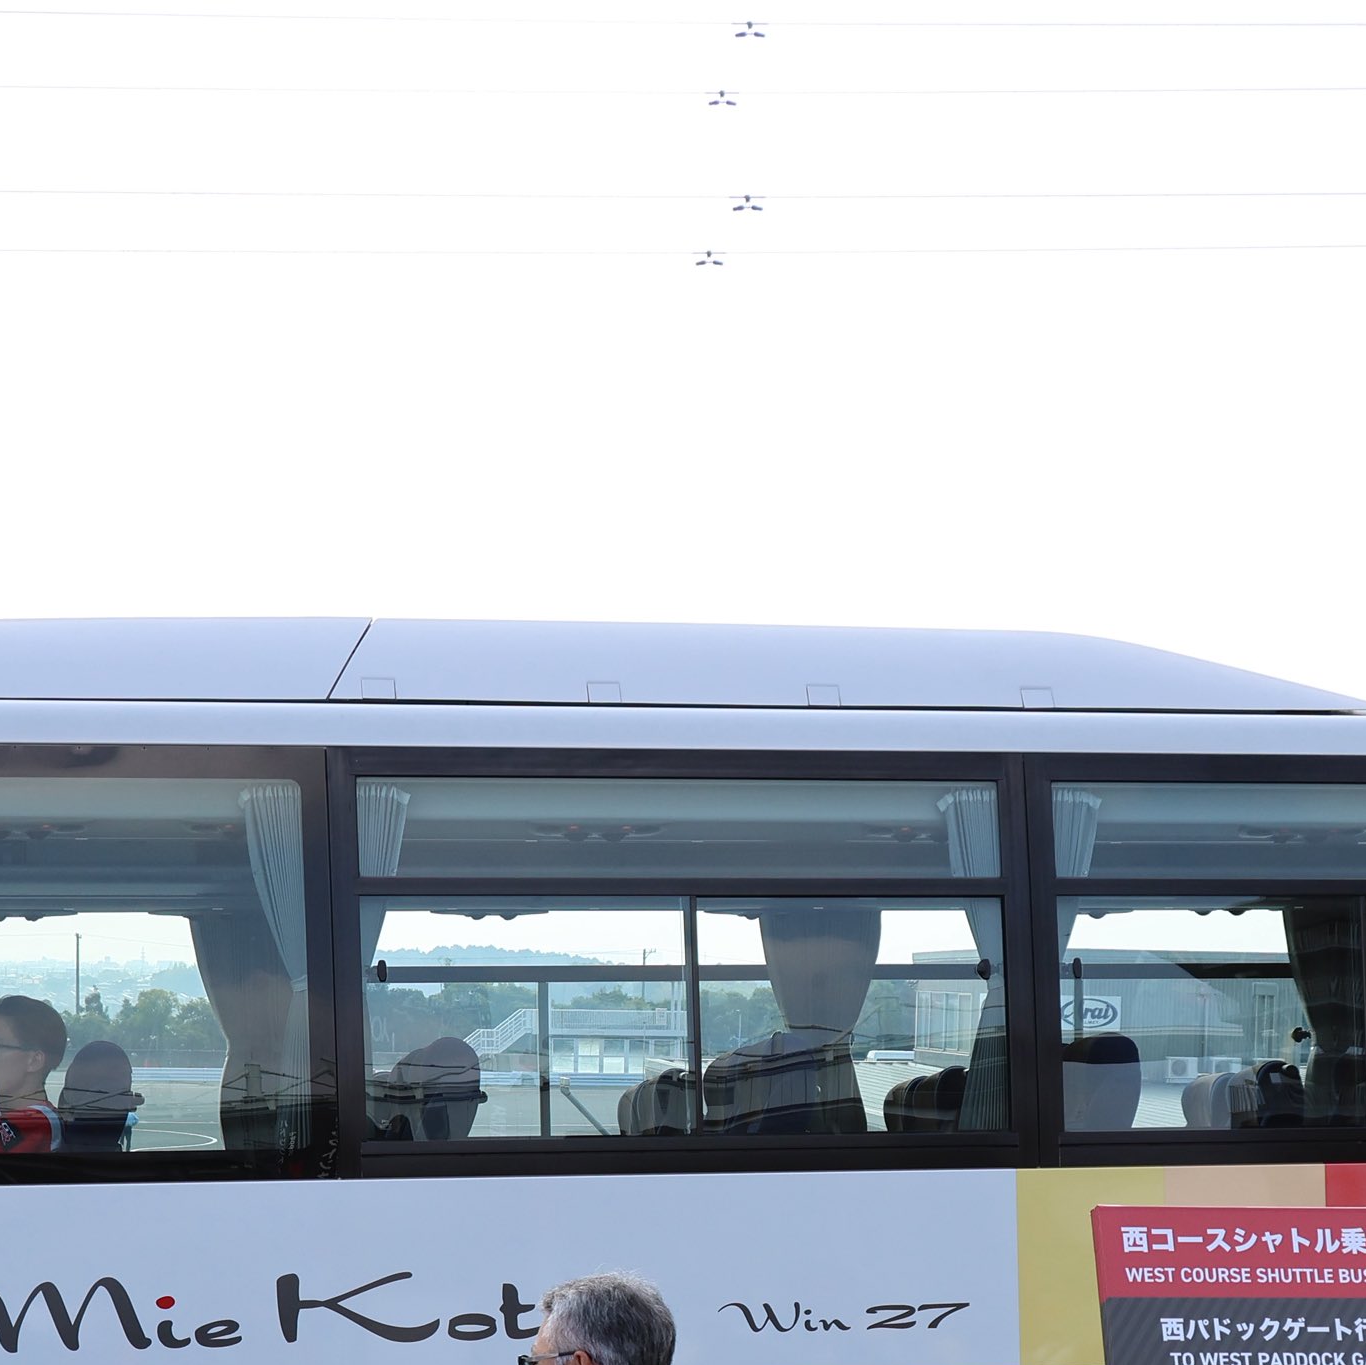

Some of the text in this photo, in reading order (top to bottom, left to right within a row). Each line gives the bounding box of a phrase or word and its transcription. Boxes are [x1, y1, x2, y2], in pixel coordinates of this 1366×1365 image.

[1125, 1268, 1175, 1282] WEST
[1181, 1268, 1251, 1282] COURSE
[1256, 1268, 1334, 1283] SHUTTLE
[275, 1270, 540, 1345] Kot
[718, 1300, 852, 1332] Win
[866, 1303, 972, 1330] 27
